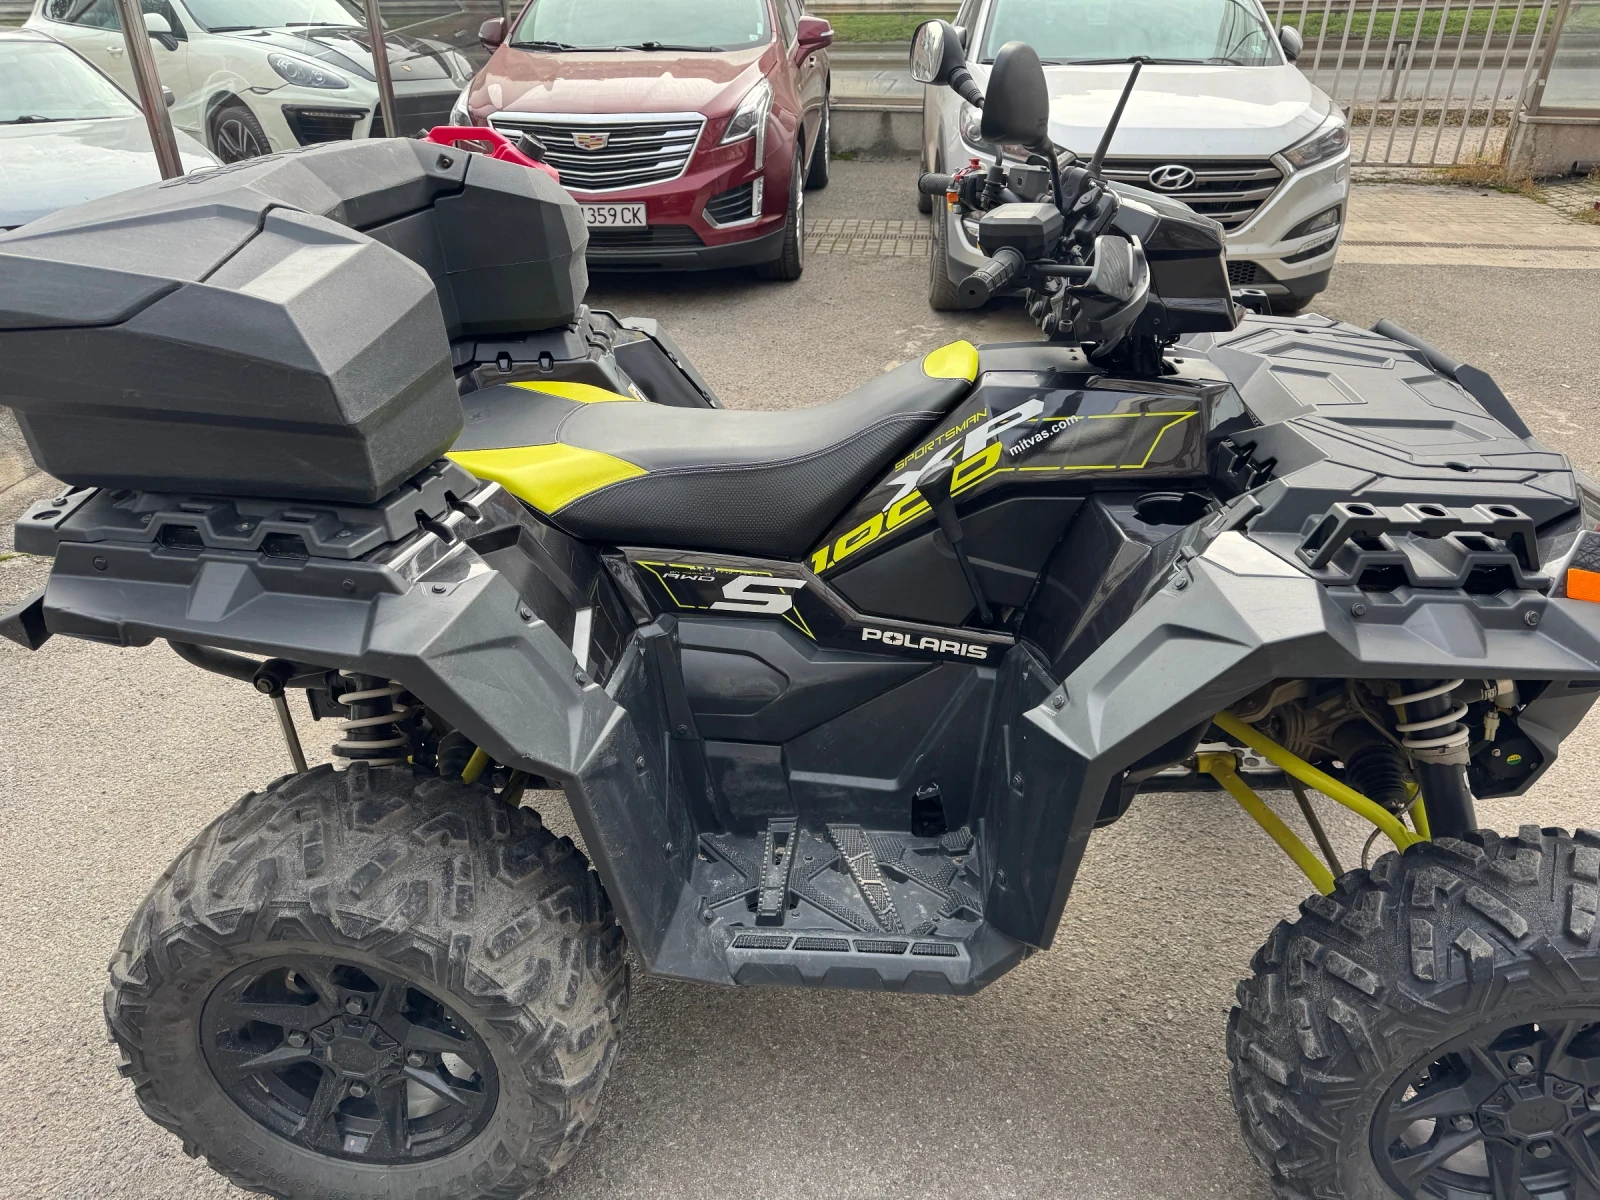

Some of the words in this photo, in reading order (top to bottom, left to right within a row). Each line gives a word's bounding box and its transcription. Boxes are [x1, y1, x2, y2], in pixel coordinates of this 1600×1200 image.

[620, 207, 643, 224] CK
[881, 398, 1045, 513] XP
[894, 408, 989, 473] SPORTSMAN
[1008, 413, 1079, 457] mitvas.com
[710, 575, 807, 614] S
[861, 627, 988, 660] POLARIS
